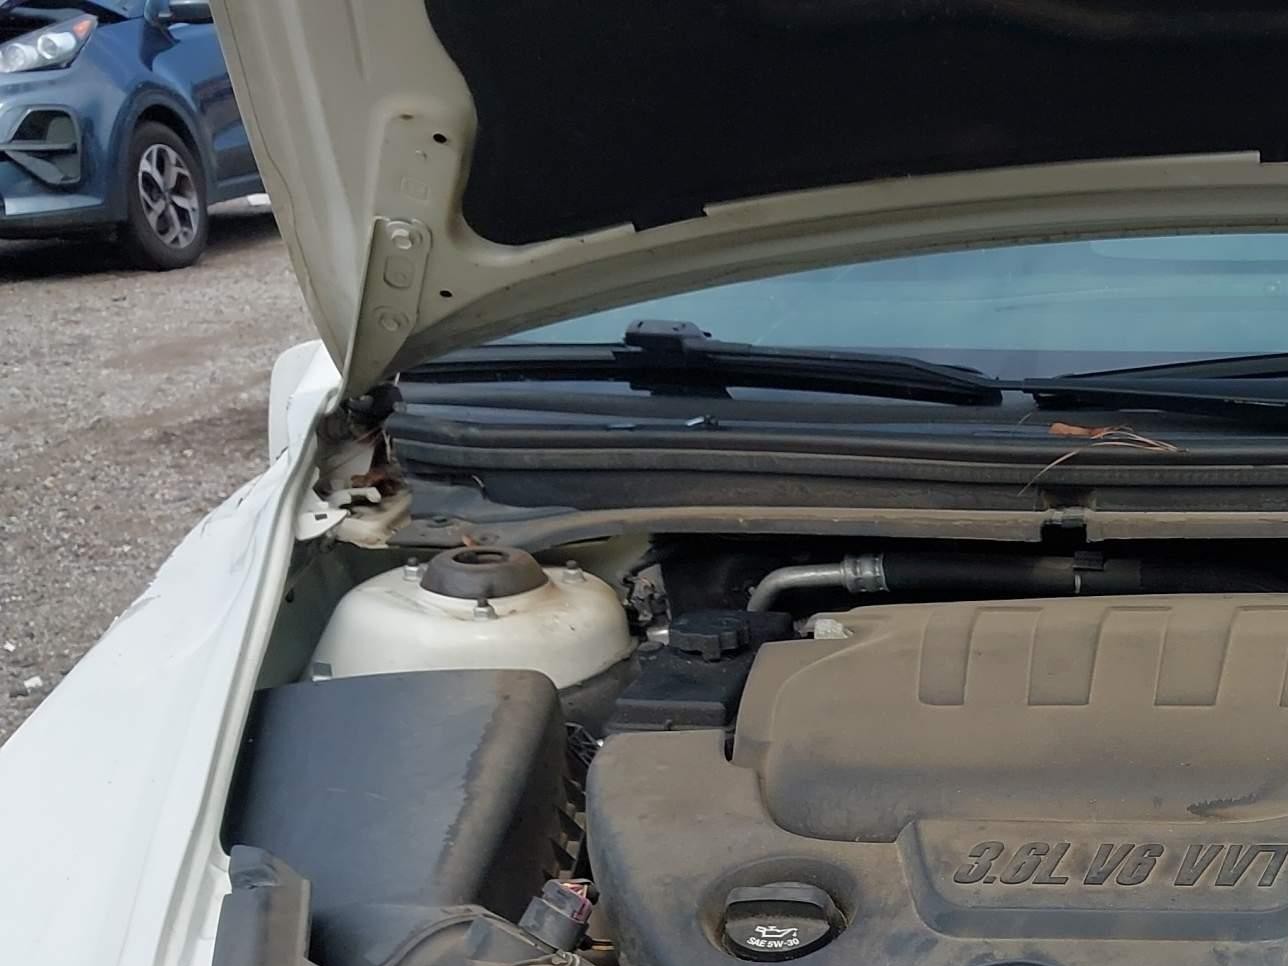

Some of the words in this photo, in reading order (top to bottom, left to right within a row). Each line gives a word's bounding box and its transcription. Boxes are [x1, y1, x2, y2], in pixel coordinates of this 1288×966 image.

[953, 841, 1072, 887] 3.6L
[1082, 843, 1165, 887] V6
[746, 937, 767, 947] SAE
[767, 938, 800, 948] 5W-30
